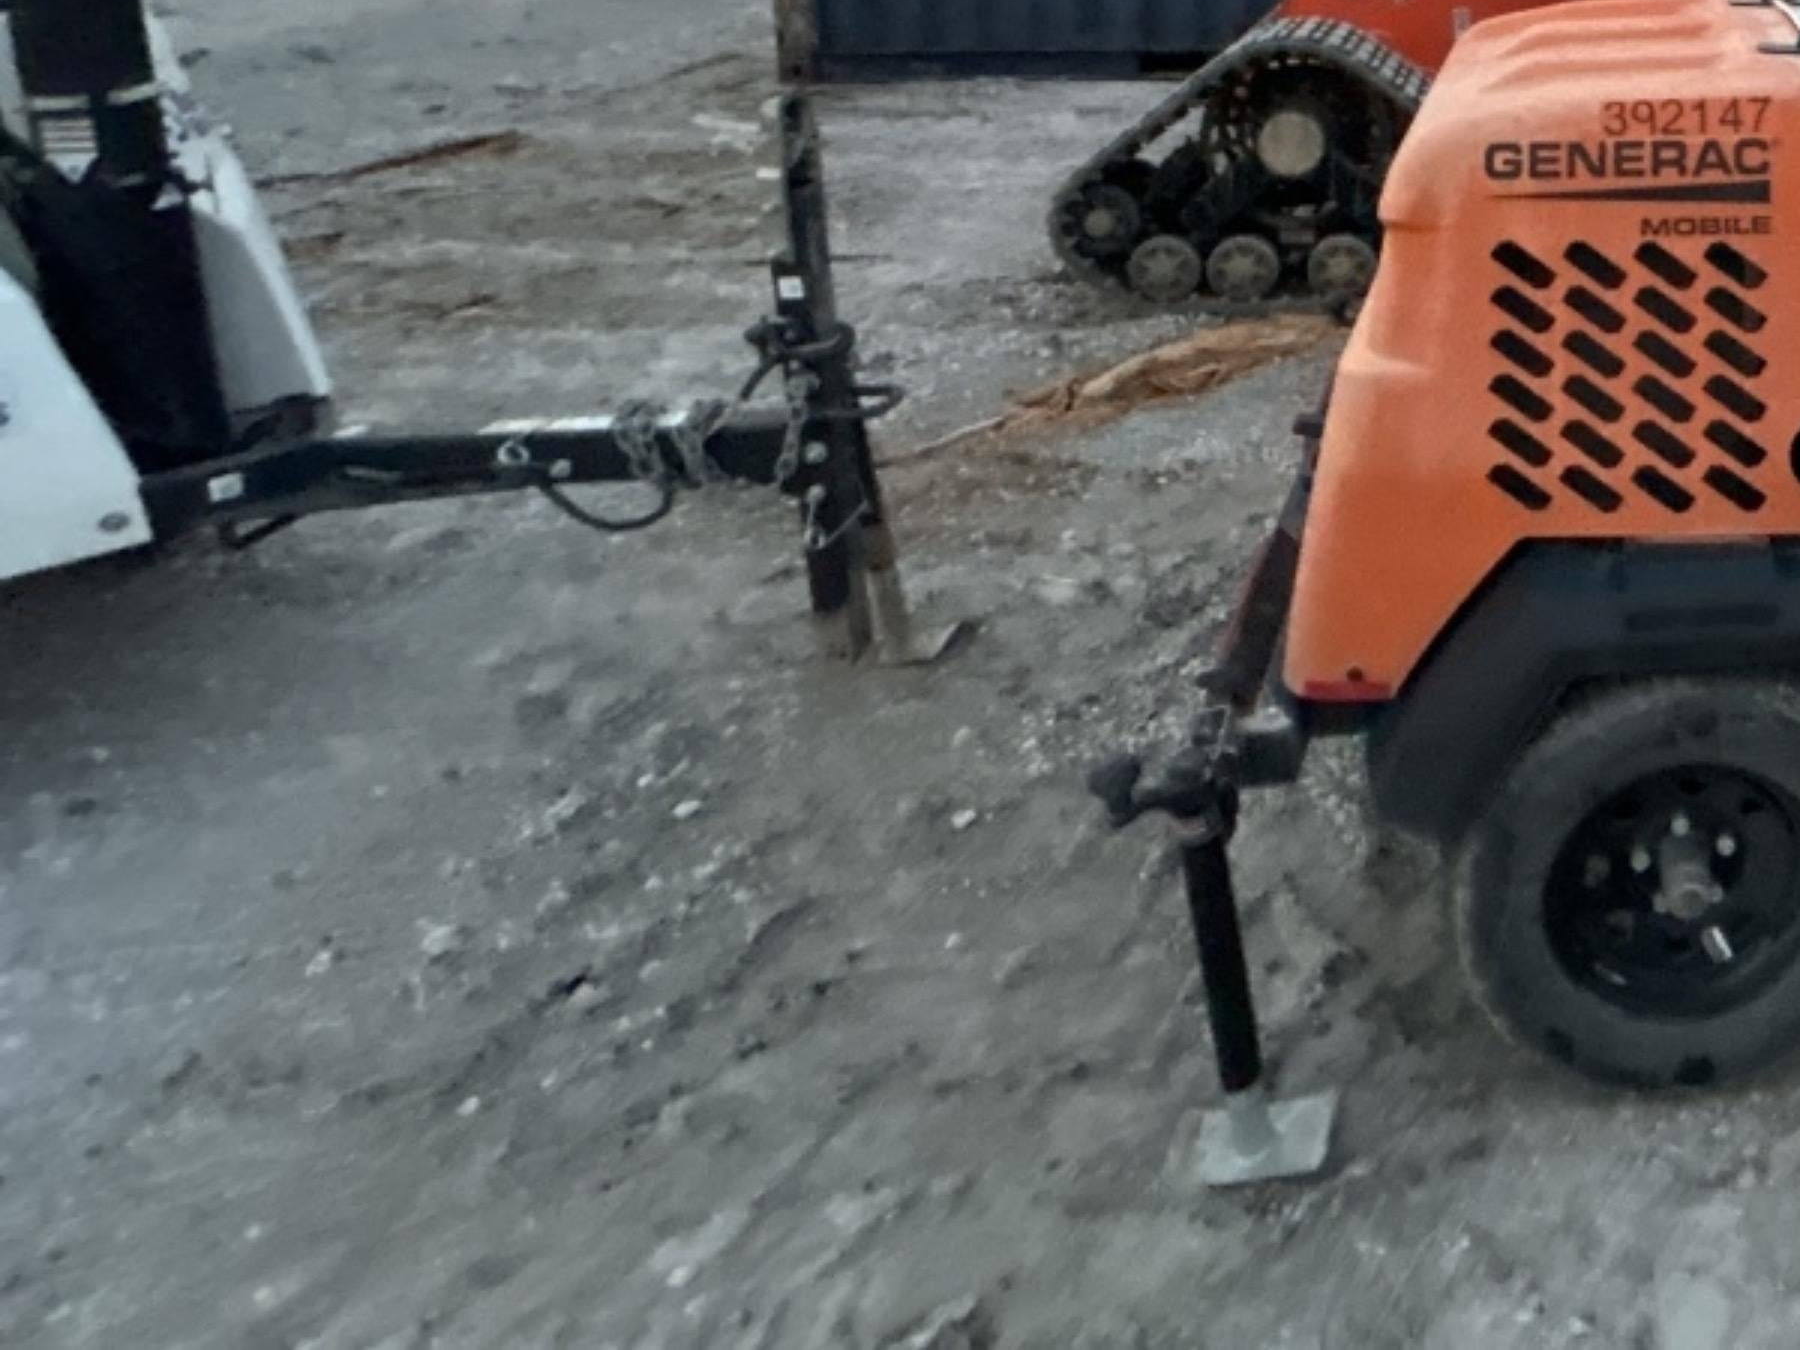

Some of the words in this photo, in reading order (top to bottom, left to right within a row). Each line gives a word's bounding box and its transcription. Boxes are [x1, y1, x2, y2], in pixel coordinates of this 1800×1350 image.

[1603, 95, 1772, 136] 392147
[1484, 137, 1771, 181] GENERAC
[1640, 215, 1772, 237] MOBILE
